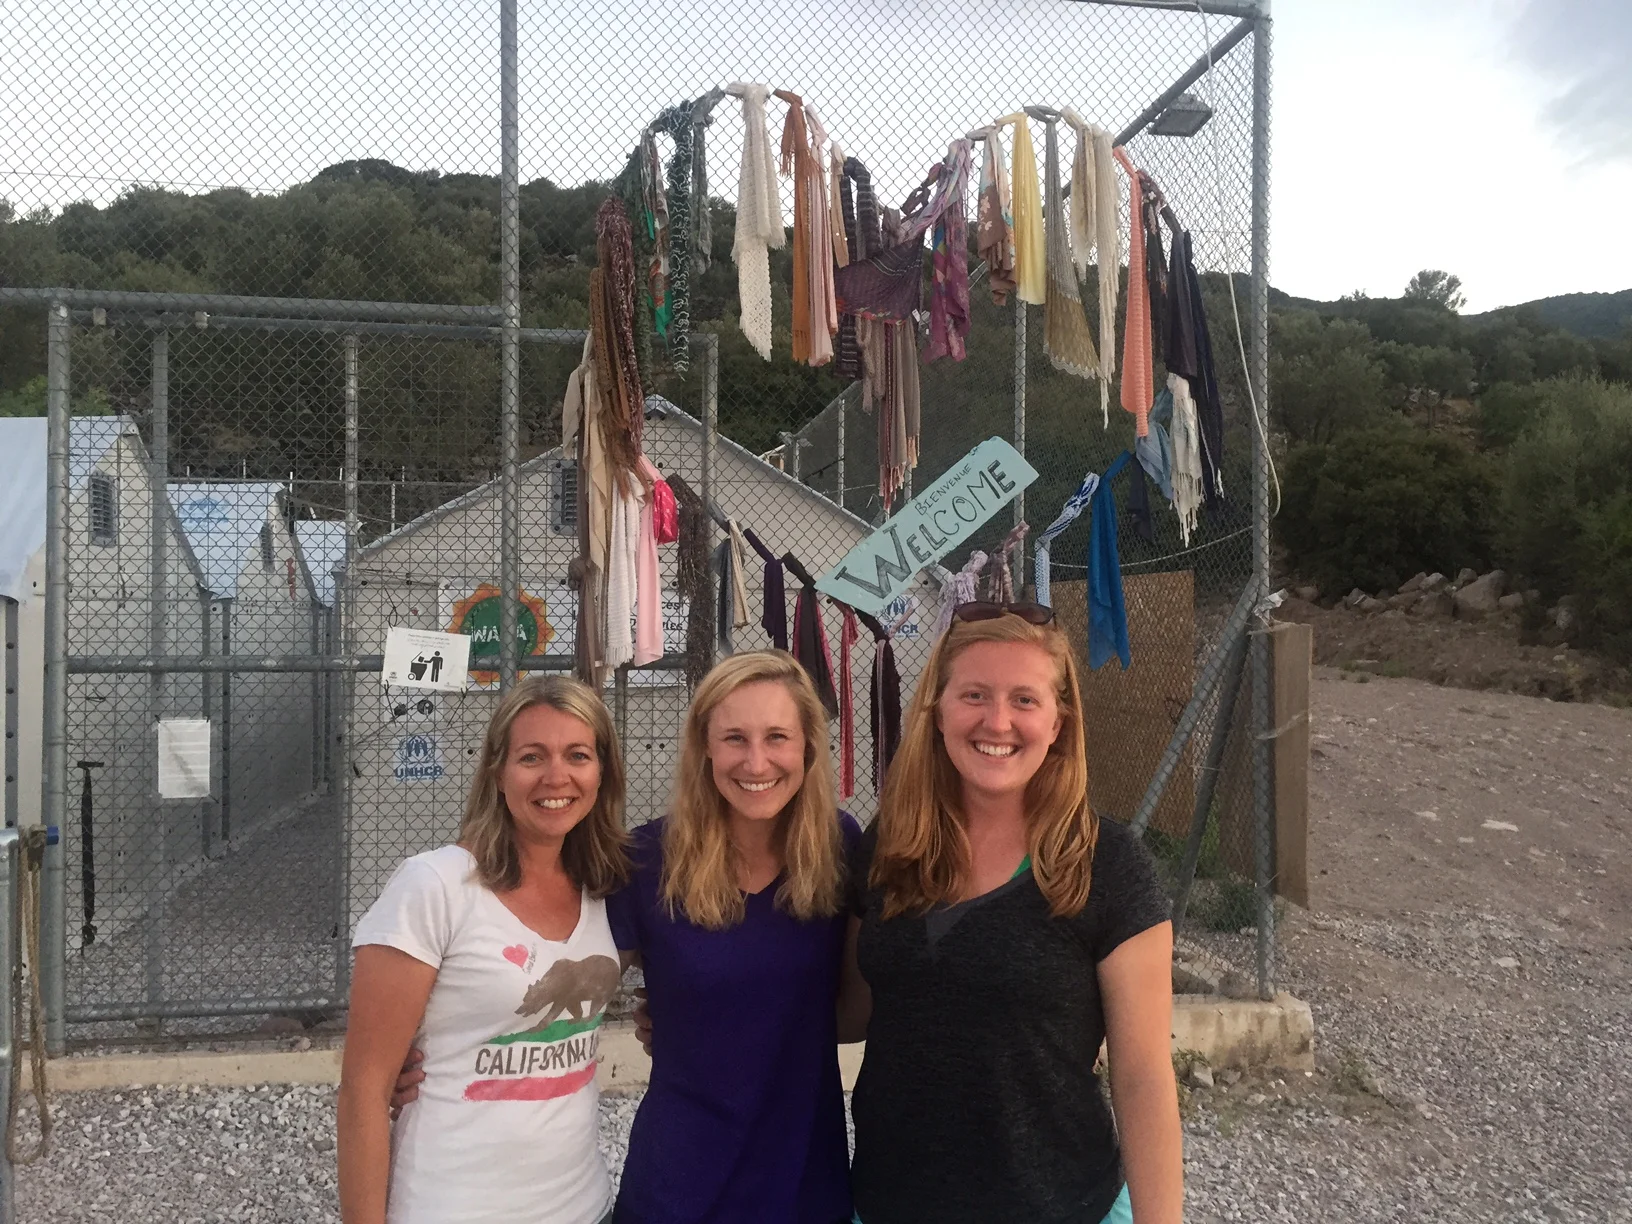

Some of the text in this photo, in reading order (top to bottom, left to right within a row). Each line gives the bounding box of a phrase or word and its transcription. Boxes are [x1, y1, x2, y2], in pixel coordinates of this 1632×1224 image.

[914, 463, 972, 515] BIENVENUE
[834, 459, 1016, 599] WELCOME
[470, 624, 528, 642] WAA
[394, 765, 443, 778] UNHCR
[475, 1037, 587, 1075] CALIFORNA
